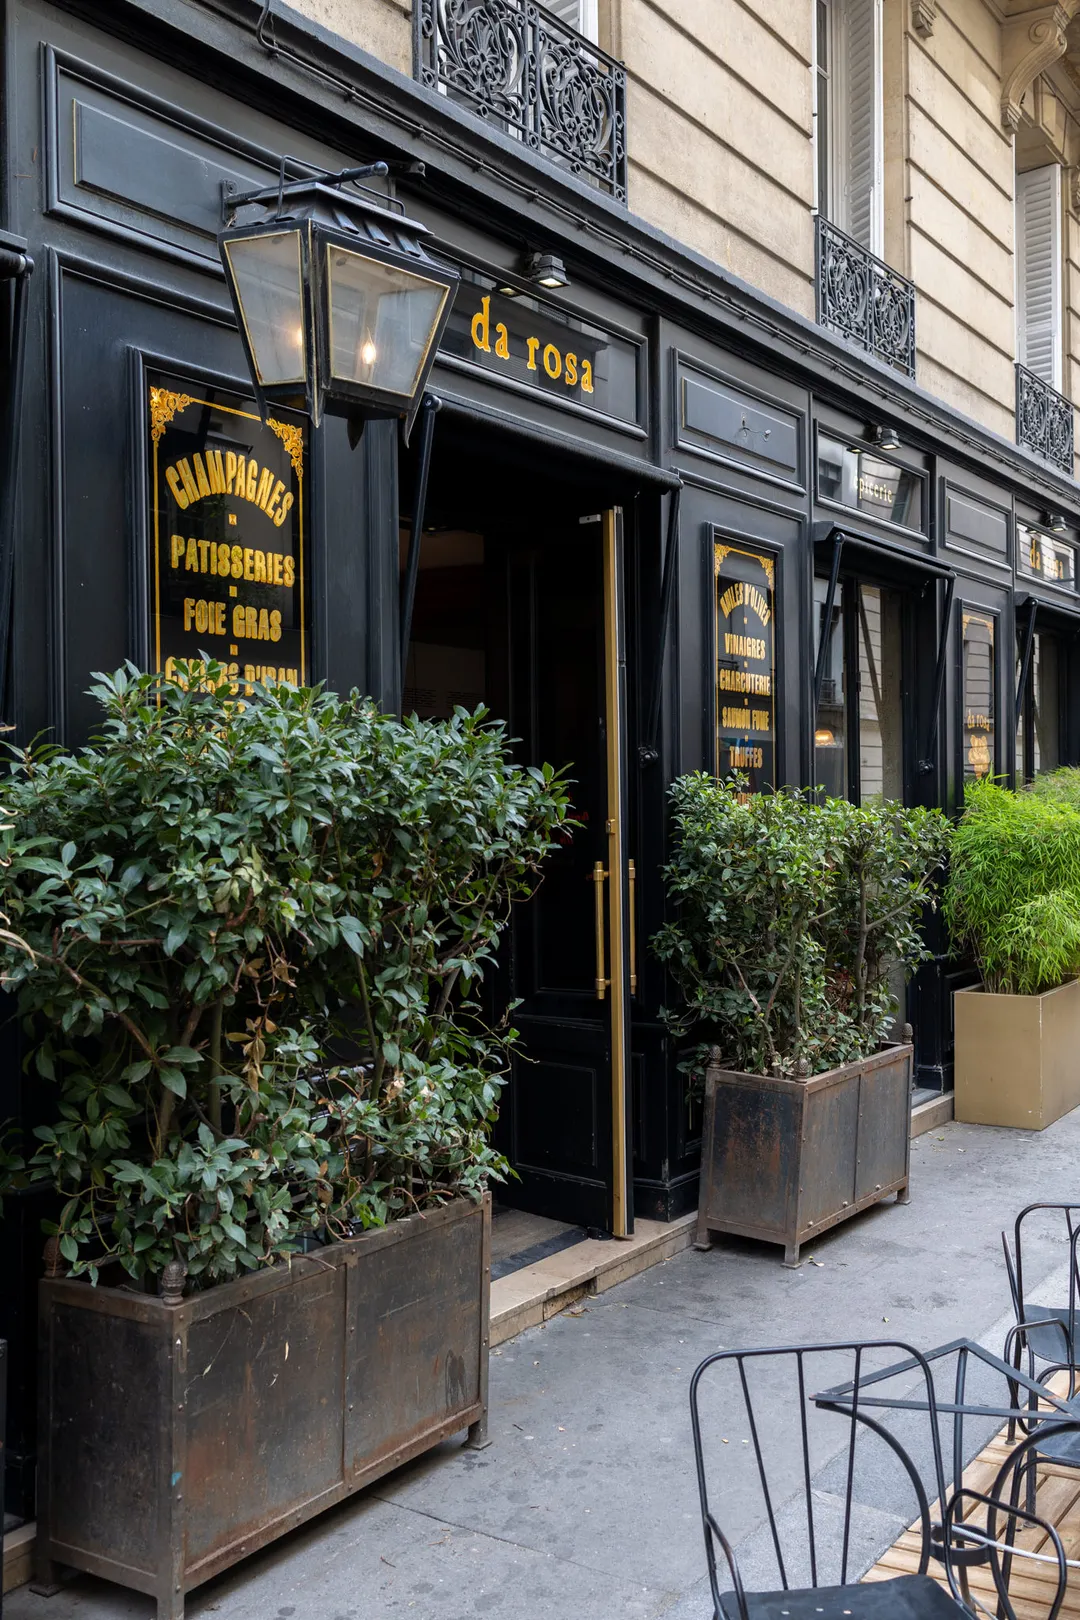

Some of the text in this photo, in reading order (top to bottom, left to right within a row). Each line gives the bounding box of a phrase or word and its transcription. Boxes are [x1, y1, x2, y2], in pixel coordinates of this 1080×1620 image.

[470, 295, 594, 394] da rosa
[165, 449, 295, 528] CHAMPAGNES
[170, 534, 295, 588] PATISSERIES
[719, 581, 744, 619] HUILES
[183, 597, 282, 643] FOIE GRAS
[724, 632, 766, 661] VINAIGRES
[719, 668, 771, 697] CHARCUTERIE
[721, 706, 751, 731] SAUMON
[967, 708, 976, 730] da
[729, 745, 763, 770] TRUFFES
